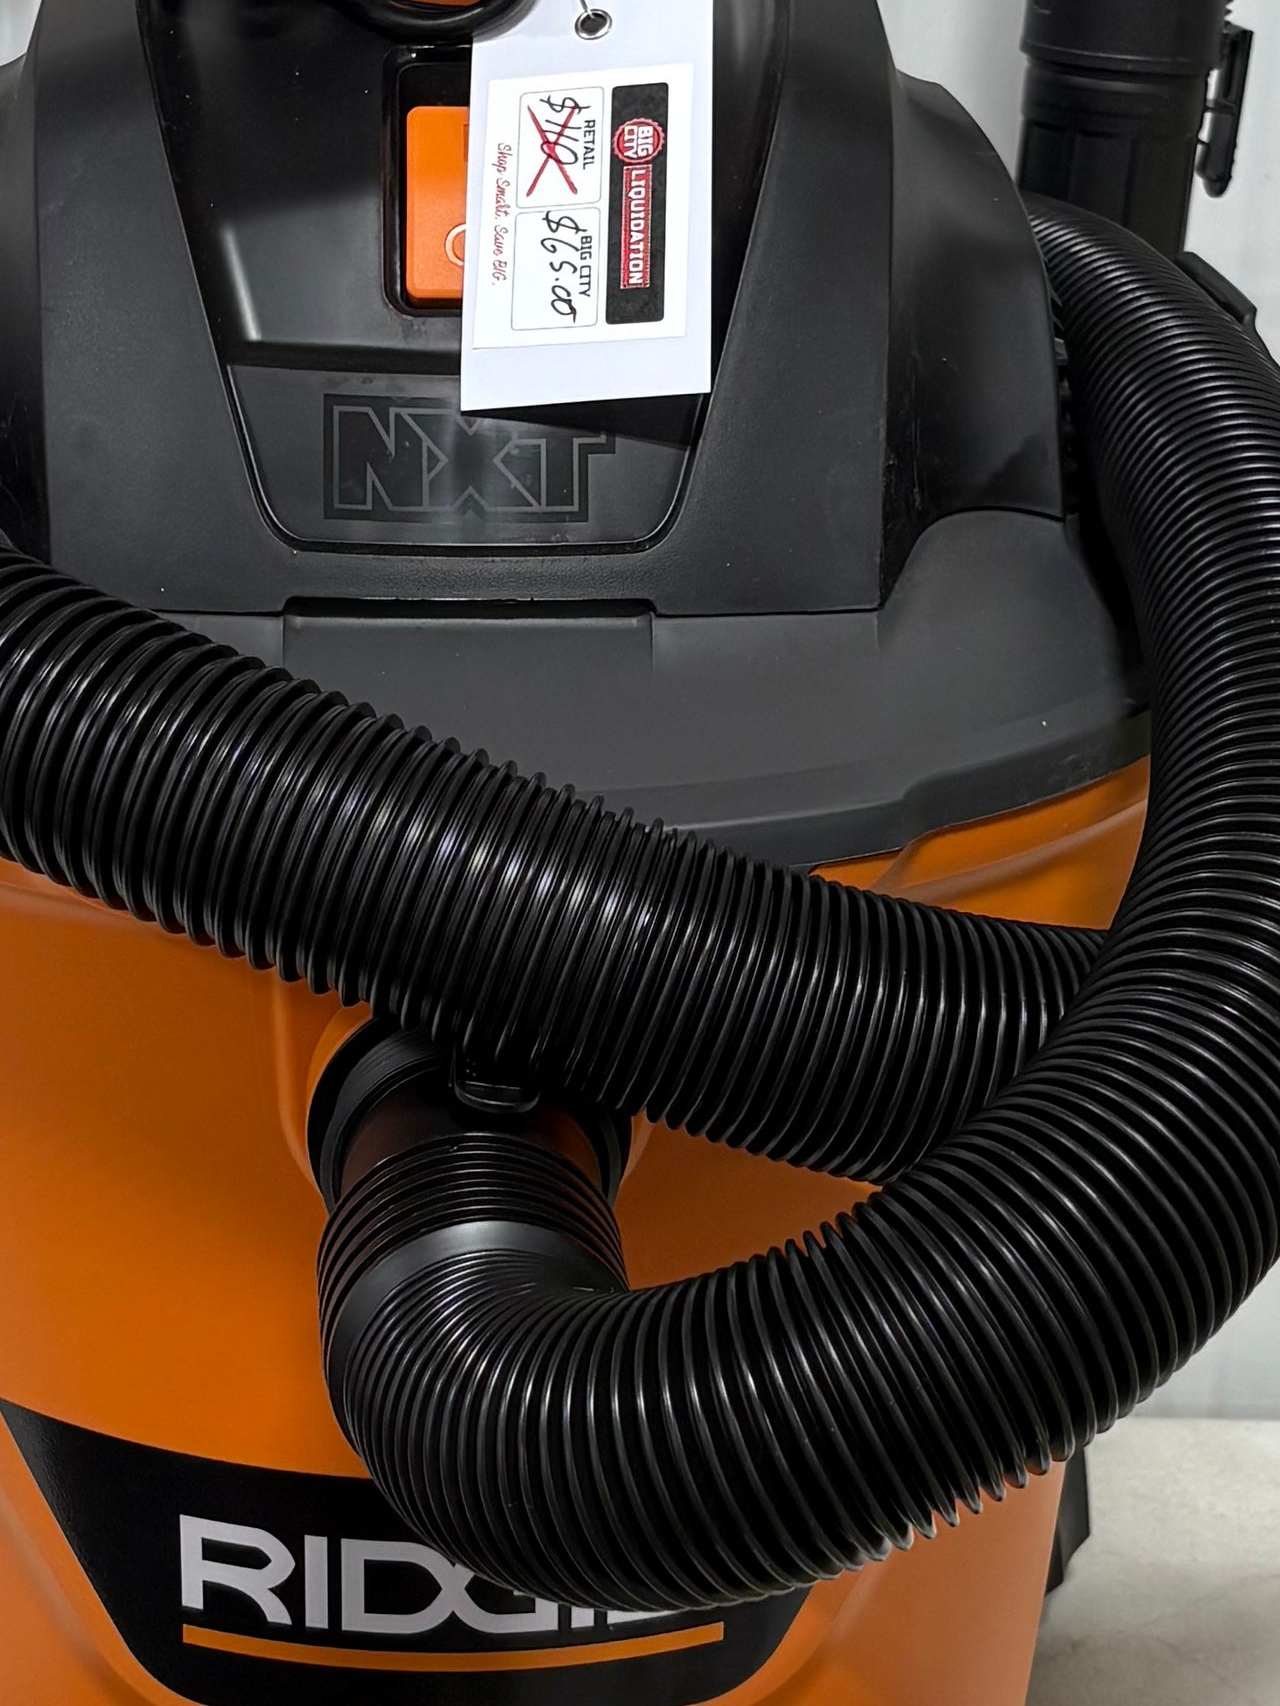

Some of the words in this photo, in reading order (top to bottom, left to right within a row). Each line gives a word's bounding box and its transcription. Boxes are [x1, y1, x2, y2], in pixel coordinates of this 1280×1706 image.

[491, 143, 513, 173] Shop
[582, 119, 596, 170] RETAIL
[623, 125, 639, 160] CITY
[637, 125, 655, 158] BIG
[494, 177, 511, 221] Smart.
[492, 224, 509, 257] Save
[628, 169, 646, 285] LIQUIDATION
[580, 235, 593, 260] BIG
[578, 265, 591, 297] CITY
[326, 399, 613, 519] NXT
[179, 1514, 677, 1634] RIDG
